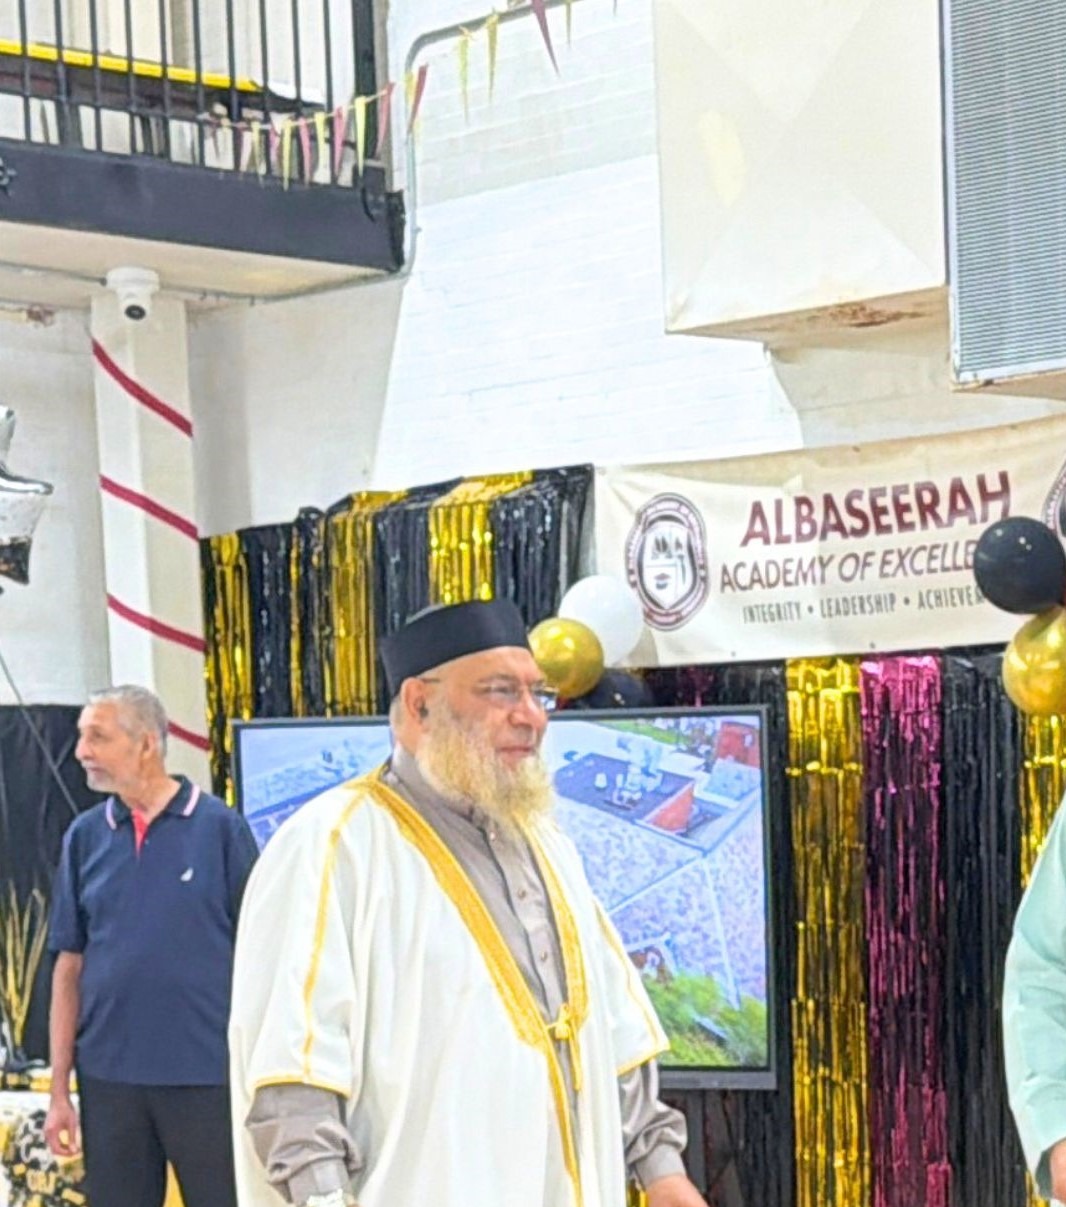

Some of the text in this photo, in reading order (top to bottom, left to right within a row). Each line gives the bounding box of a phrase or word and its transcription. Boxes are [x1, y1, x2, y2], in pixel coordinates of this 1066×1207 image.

[740, 470, 1011, 548] ALBASEERAH
[719, 553, 835, 594] ACADEMY
[838, 551, 876, 583] OF
[742, 600, 801, 626] INTEGRITY
[820, 592, 897, 619] LEADERSHIP
